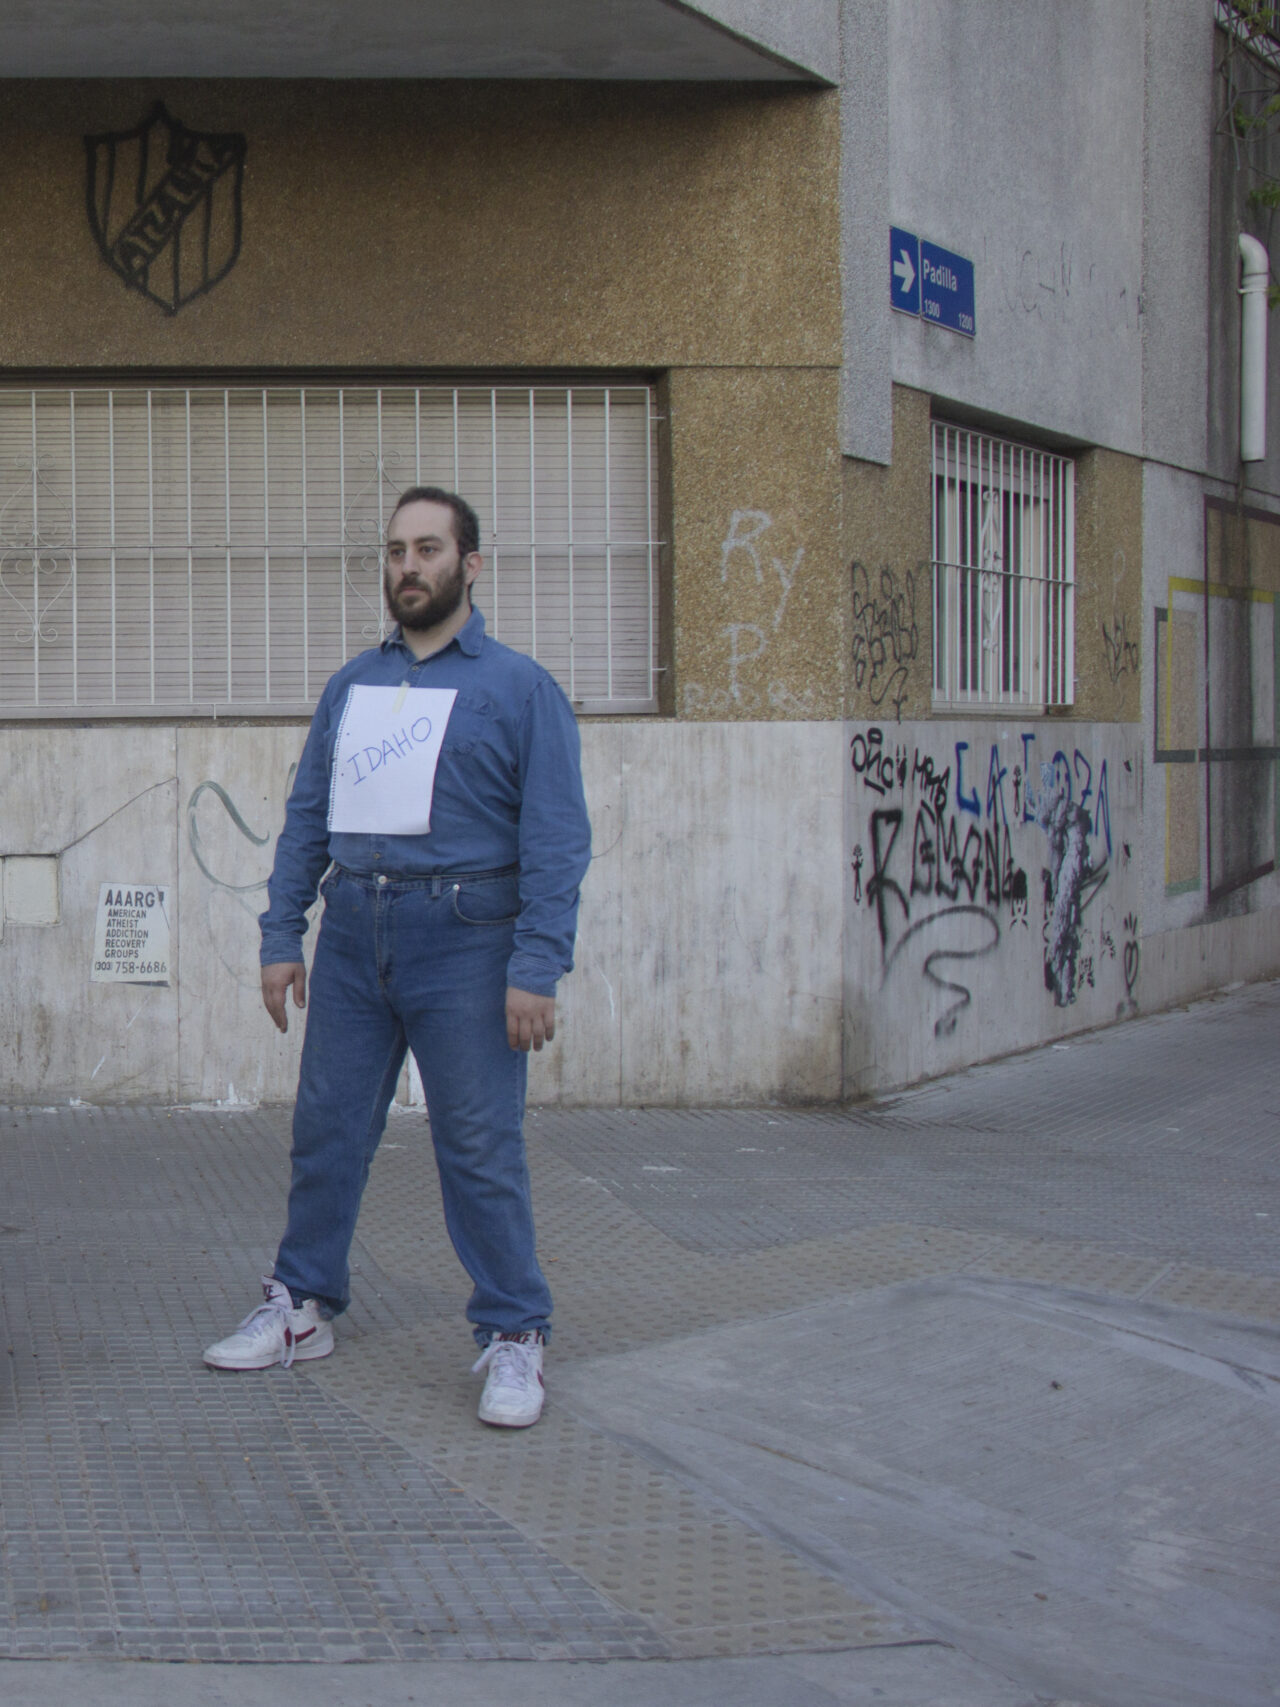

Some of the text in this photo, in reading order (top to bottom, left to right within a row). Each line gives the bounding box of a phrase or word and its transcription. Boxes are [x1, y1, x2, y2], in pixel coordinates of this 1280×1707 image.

[923, 258, 958, 292] Padilla
[924, 298, 973, 331] 1300 1200
[347, 716, 432, 786] IDAHO
[105, 889, 156, 908] AAARG
[107, 908, 147, 919] AMERICAN
[106, 918, 139, 928] ATHEIST
[106, 928, 149, 939] ADDICTION
[105, 938, 146, 948] RECOVERY
[104, 948, 139, 959] GROUPS
[94, 961, 167, 974] (303) 758-6686
